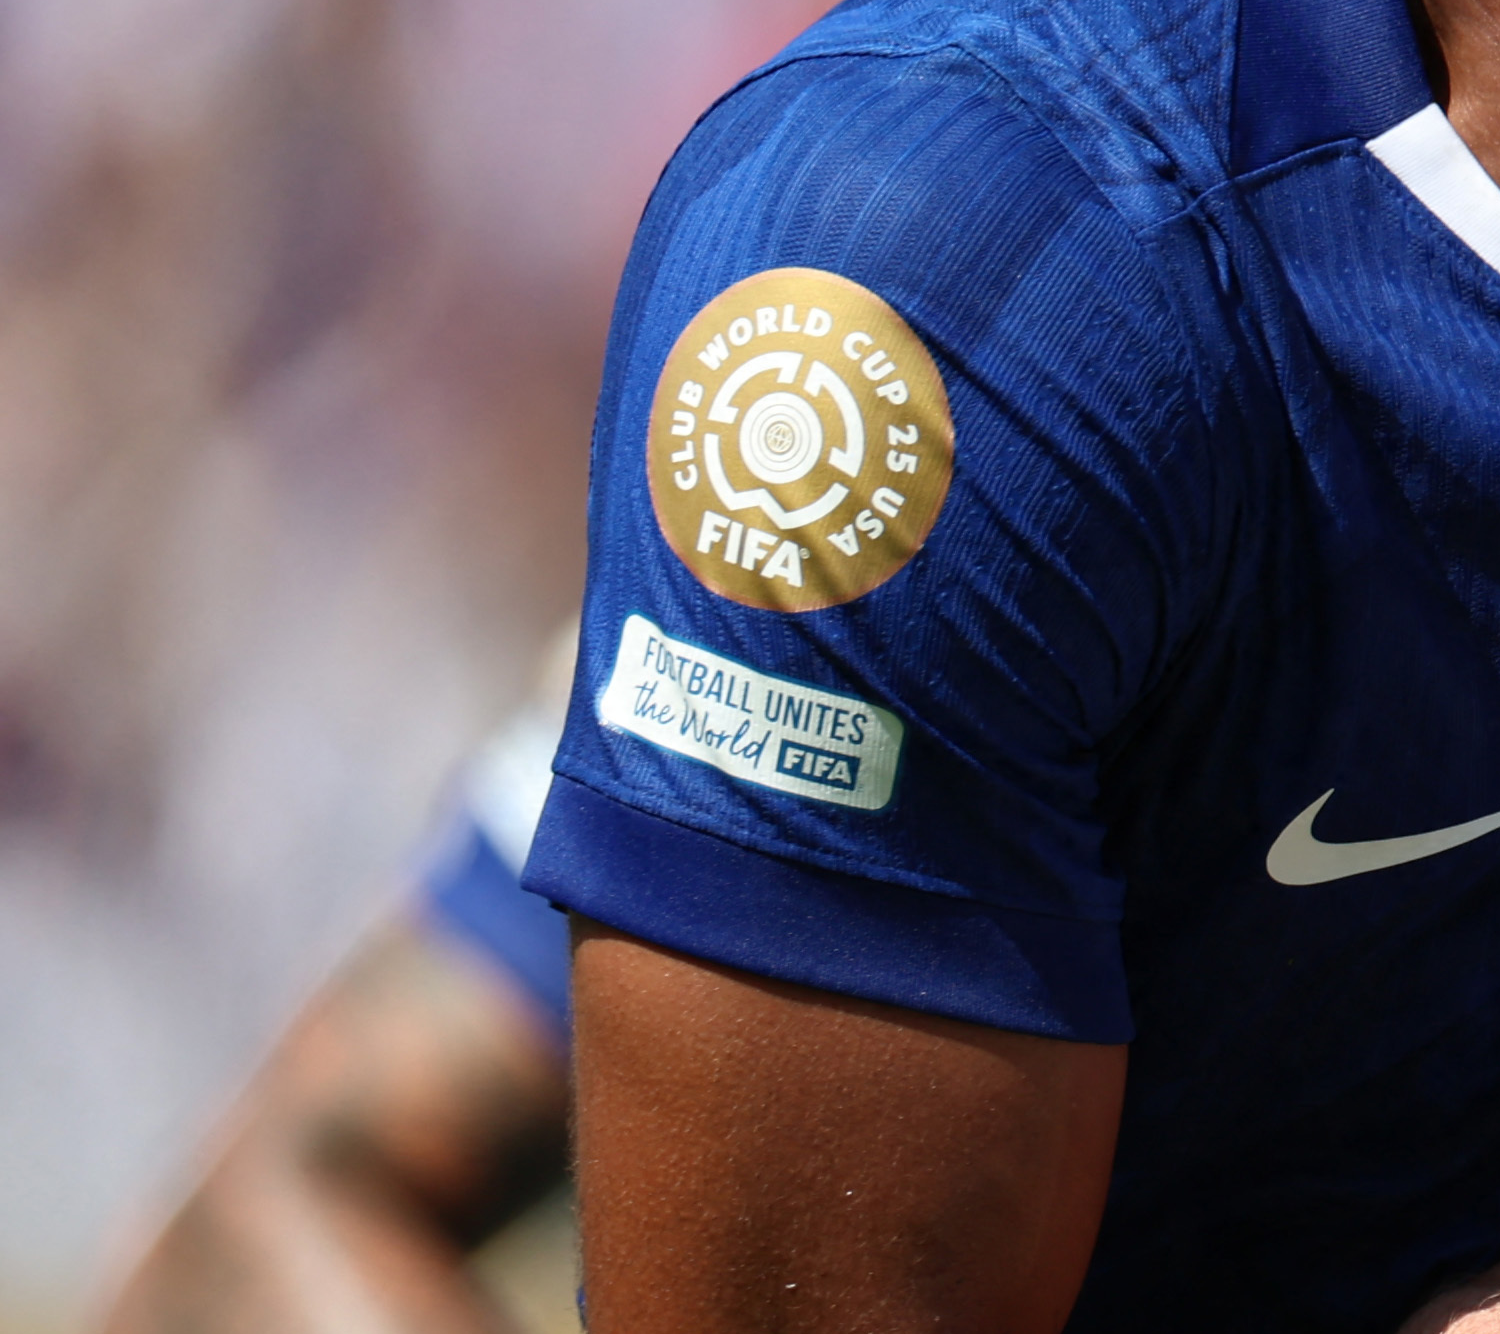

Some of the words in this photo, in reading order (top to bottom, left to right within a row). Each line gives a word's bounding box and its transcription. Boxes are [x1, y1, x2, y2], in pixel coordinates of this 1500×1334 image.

[698, 304, 833, 373] WORLD
[841, 331, 909, 408] CUP
[669, 378, 705, 492] CLUB
[885, 423, 920, 475] 25
[698, 510, 806, 588] FIFA
[827, 488, 905, 557] USA
[632, 679, 676, 726] the
[677, 700, 772, 763] World
[644, 636, 753, 714] FOOTBALL
[763, 688, 868, 745] UNITES
[782, 748, 854, 785] FIFA
